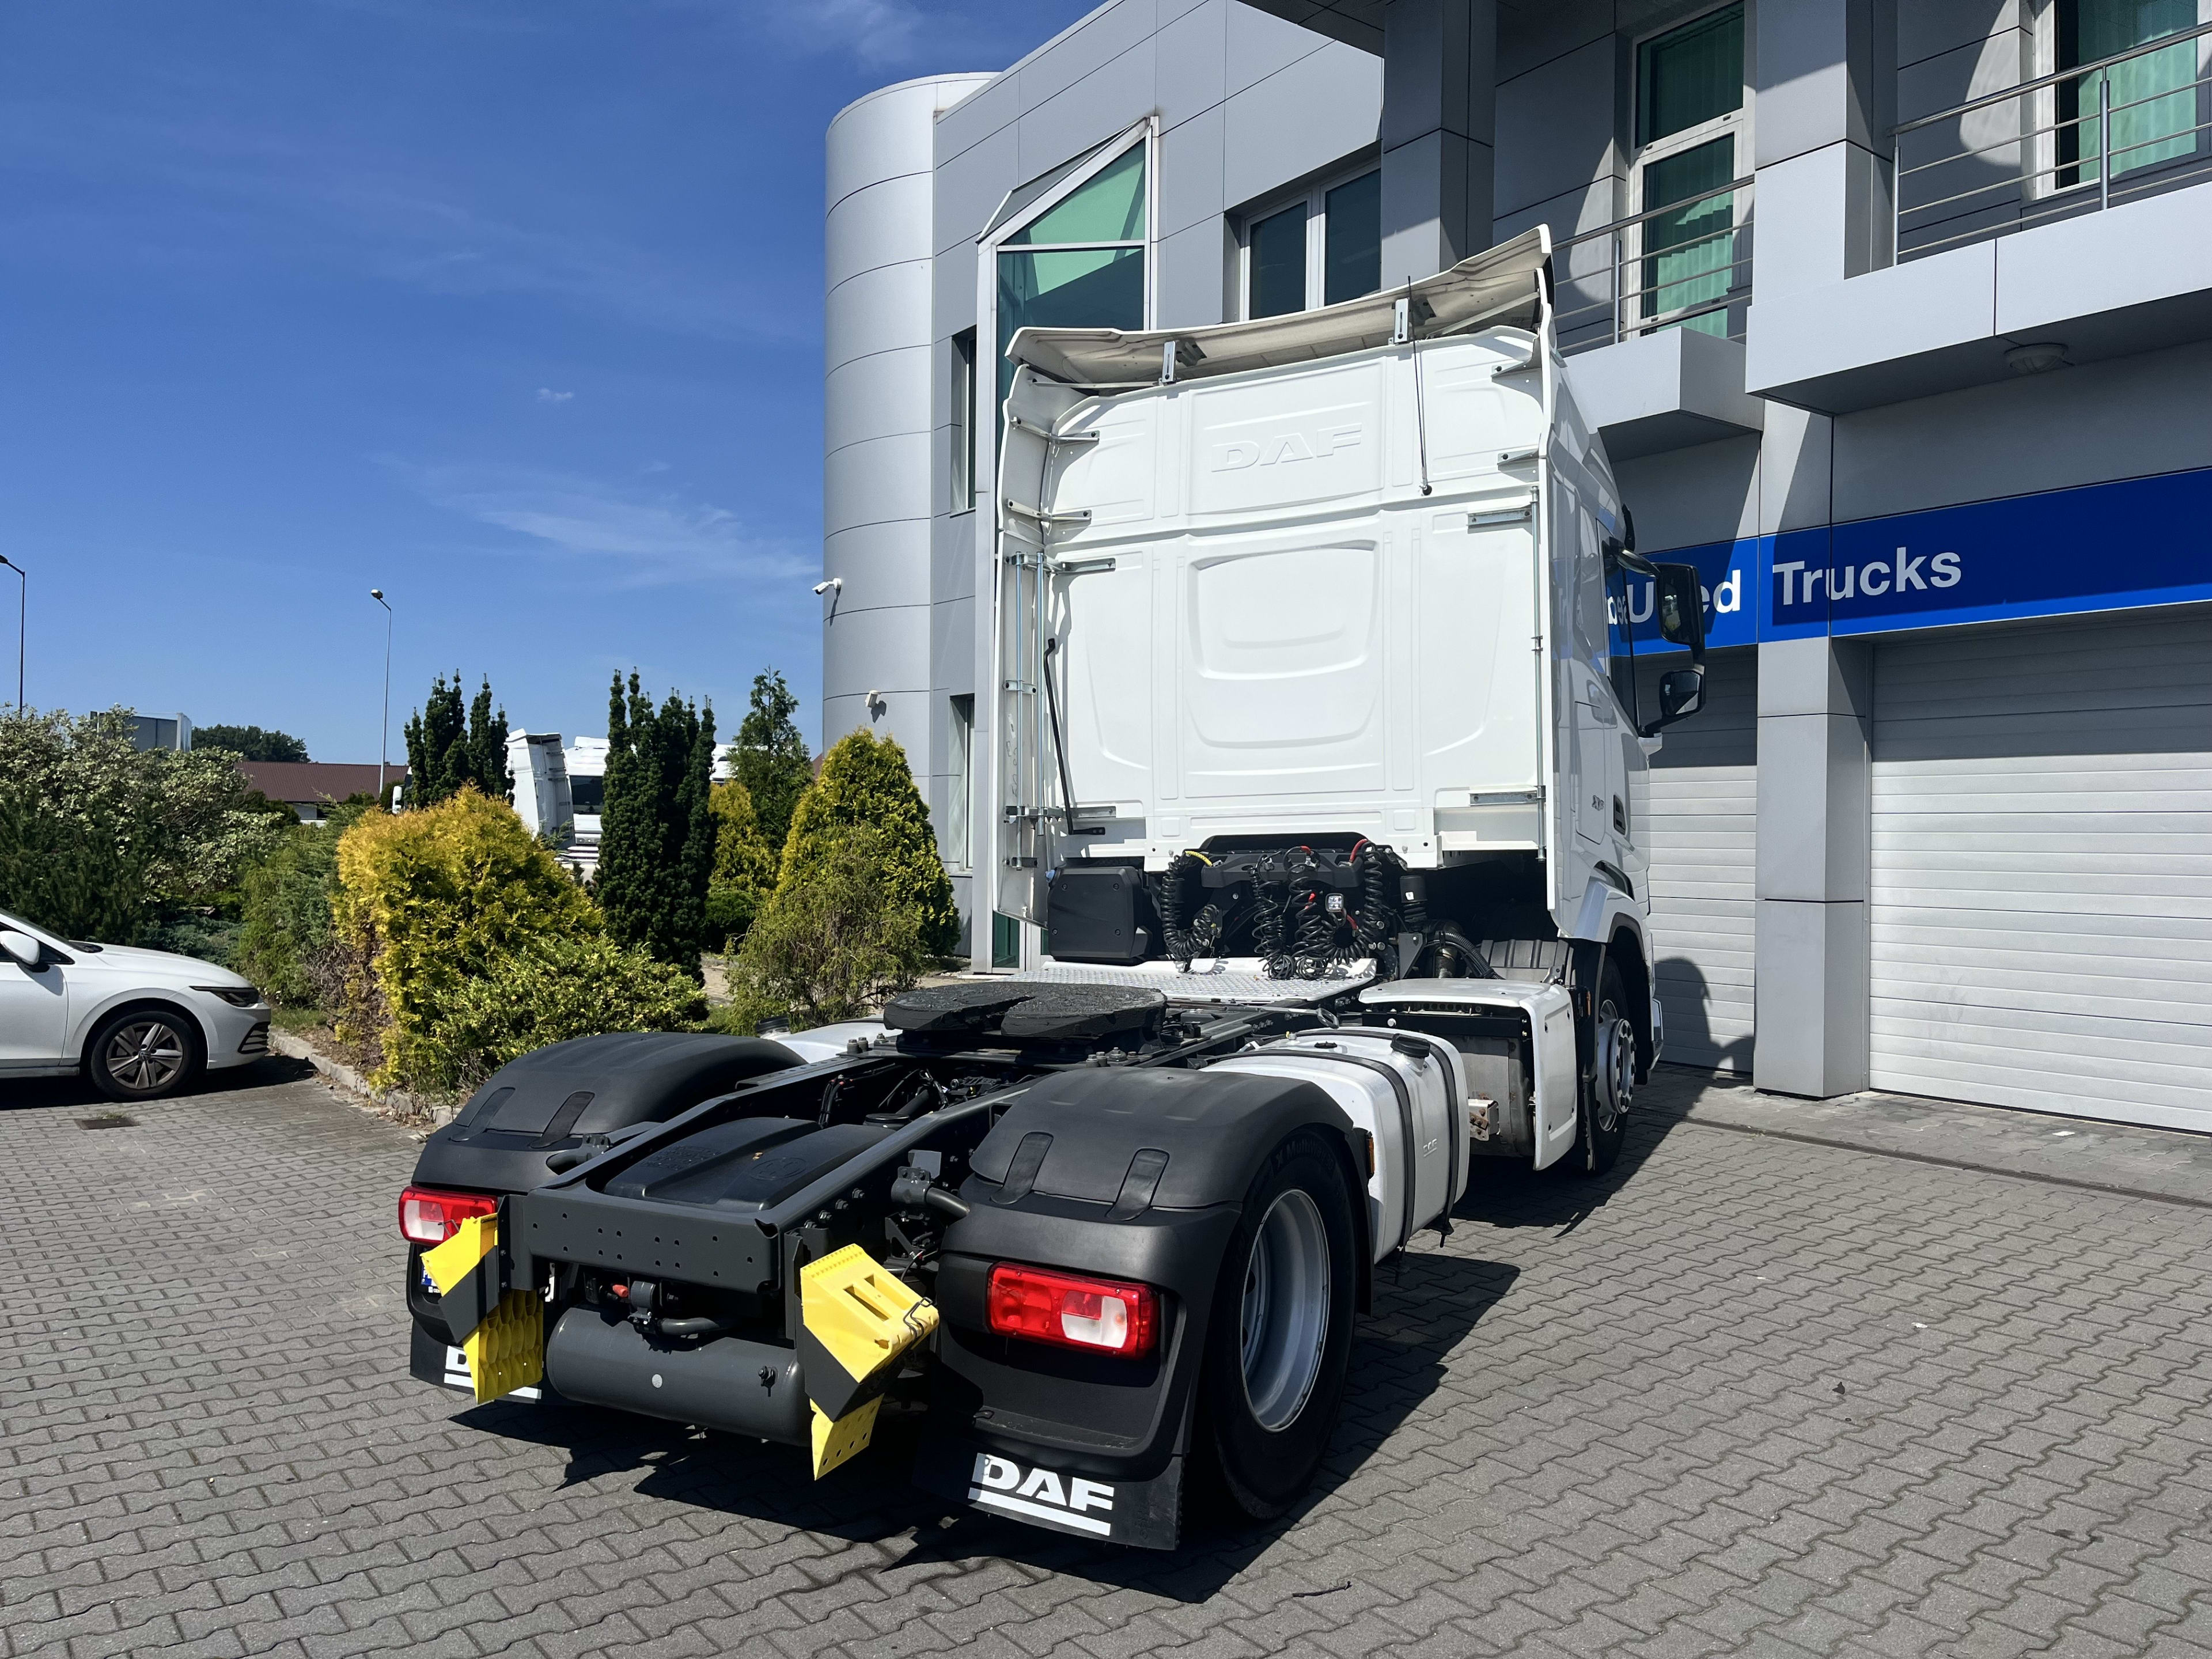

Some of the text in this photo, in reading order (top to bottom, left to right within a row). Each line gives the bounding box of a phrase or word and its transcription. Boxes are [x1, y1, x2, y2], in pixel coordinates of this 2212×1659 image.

[1211, 425, 1362, 472] DAF
[1627, 569, 1742, 623] Ued
[1773, 547, 1962, 606] Trucks
[971, 1452, 1115, 1511] DAF
